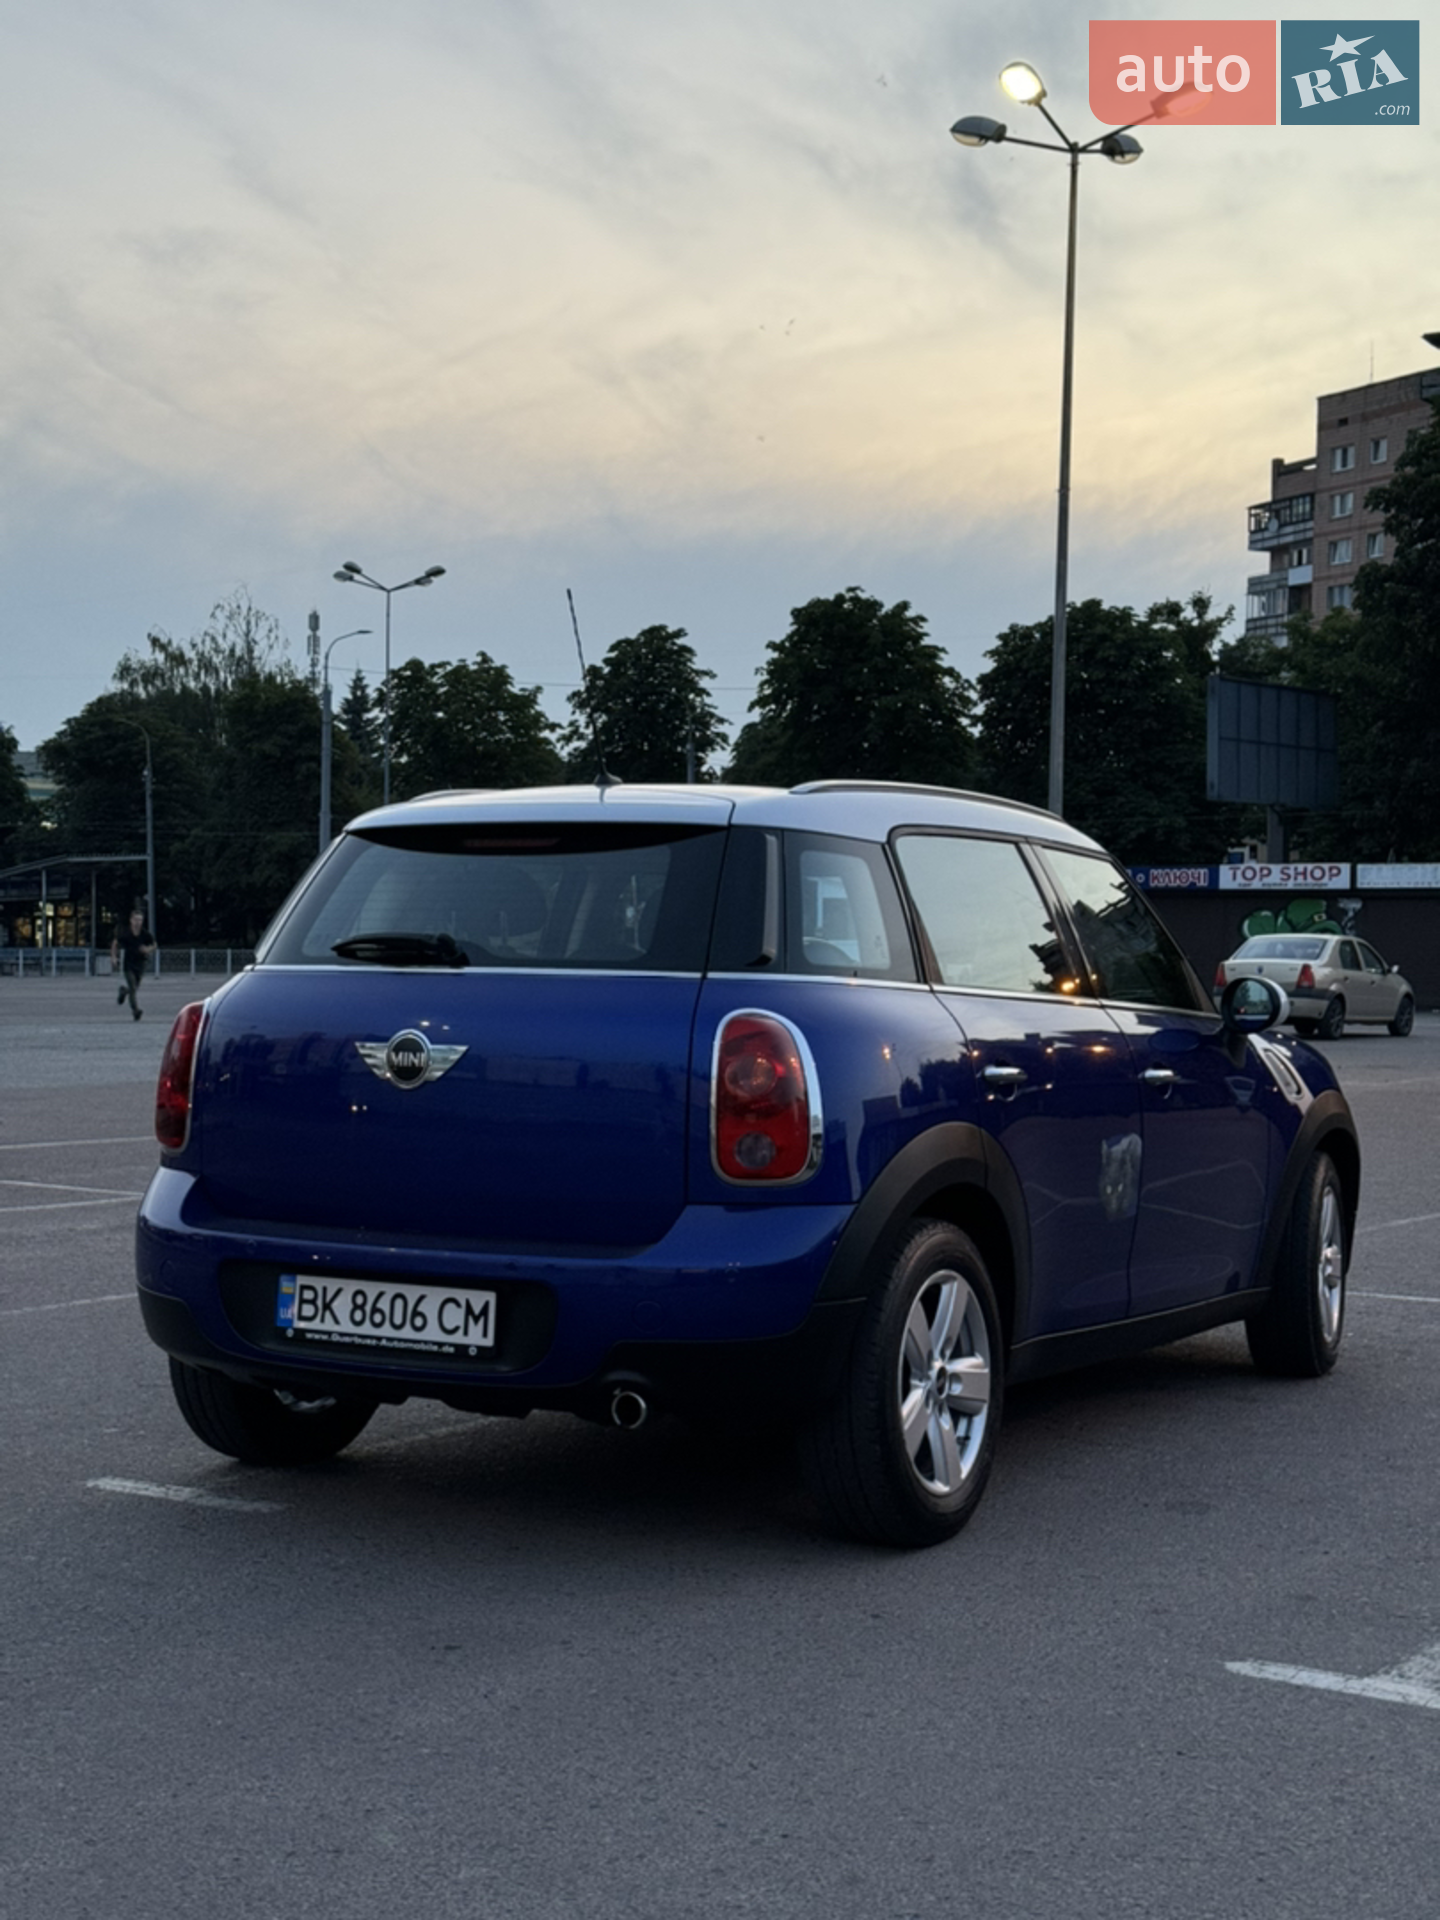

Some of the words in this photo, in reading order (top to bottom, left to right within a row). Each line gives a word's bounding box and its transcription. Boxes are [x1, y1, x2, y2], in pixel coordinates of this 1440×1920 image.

[1149, 868, 1209, 887] КЛЮЧІ
[1229, 866, 1272, 882] TOP
[1280, 865, 1342, 882] SHOP
[391, 1051, 425, 1067] MINI
[297, 1284, 344, 1325] BK
[349, 1289, 429, 1333] 8606
[437, 1296, 490, 1339] CM
